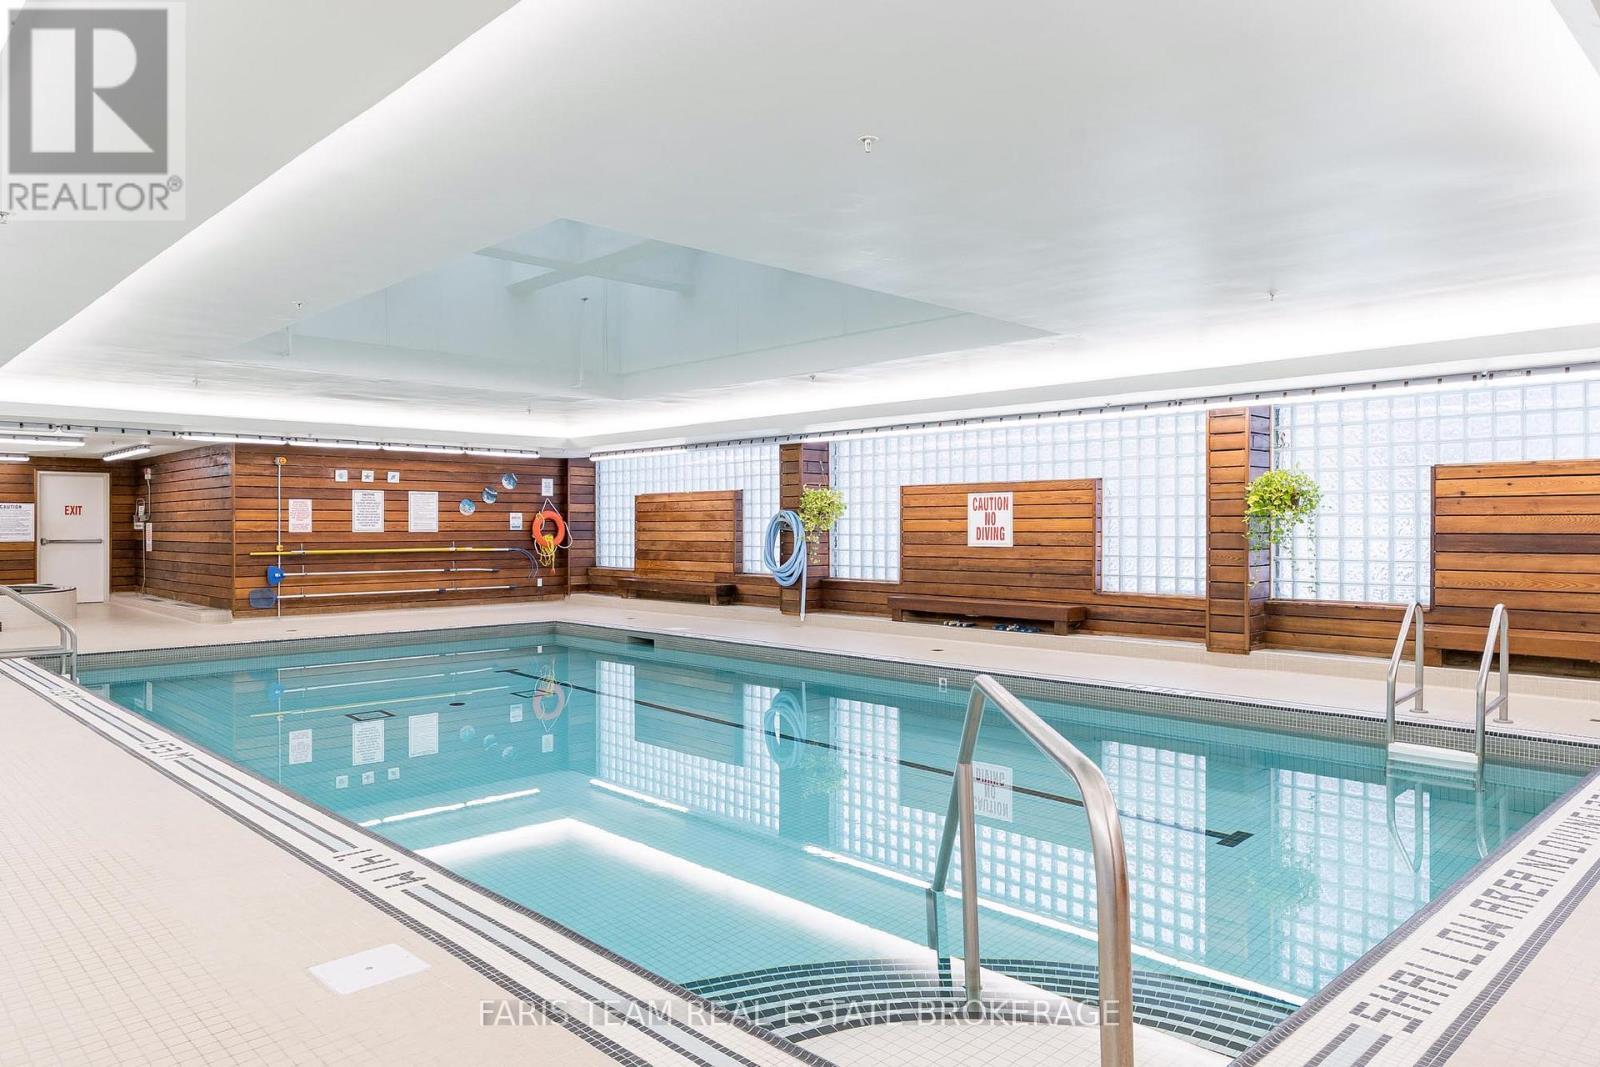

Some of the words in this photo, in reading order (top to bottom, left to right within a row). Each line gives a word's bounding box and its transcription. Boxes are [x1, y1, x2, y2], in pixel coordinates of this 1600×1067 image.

[64, 506, 83, 515] EXIT
[972, 496, 1009, 511] CAUTION
[984, 511, 996, 526] NO
[976, 526, 1006, 541] DIVING
[1349, 913, 1514, 1034] SHALLOW
[1470, 869, 1559, 919] AREA
[1516, 850, 1578, 874] NO
